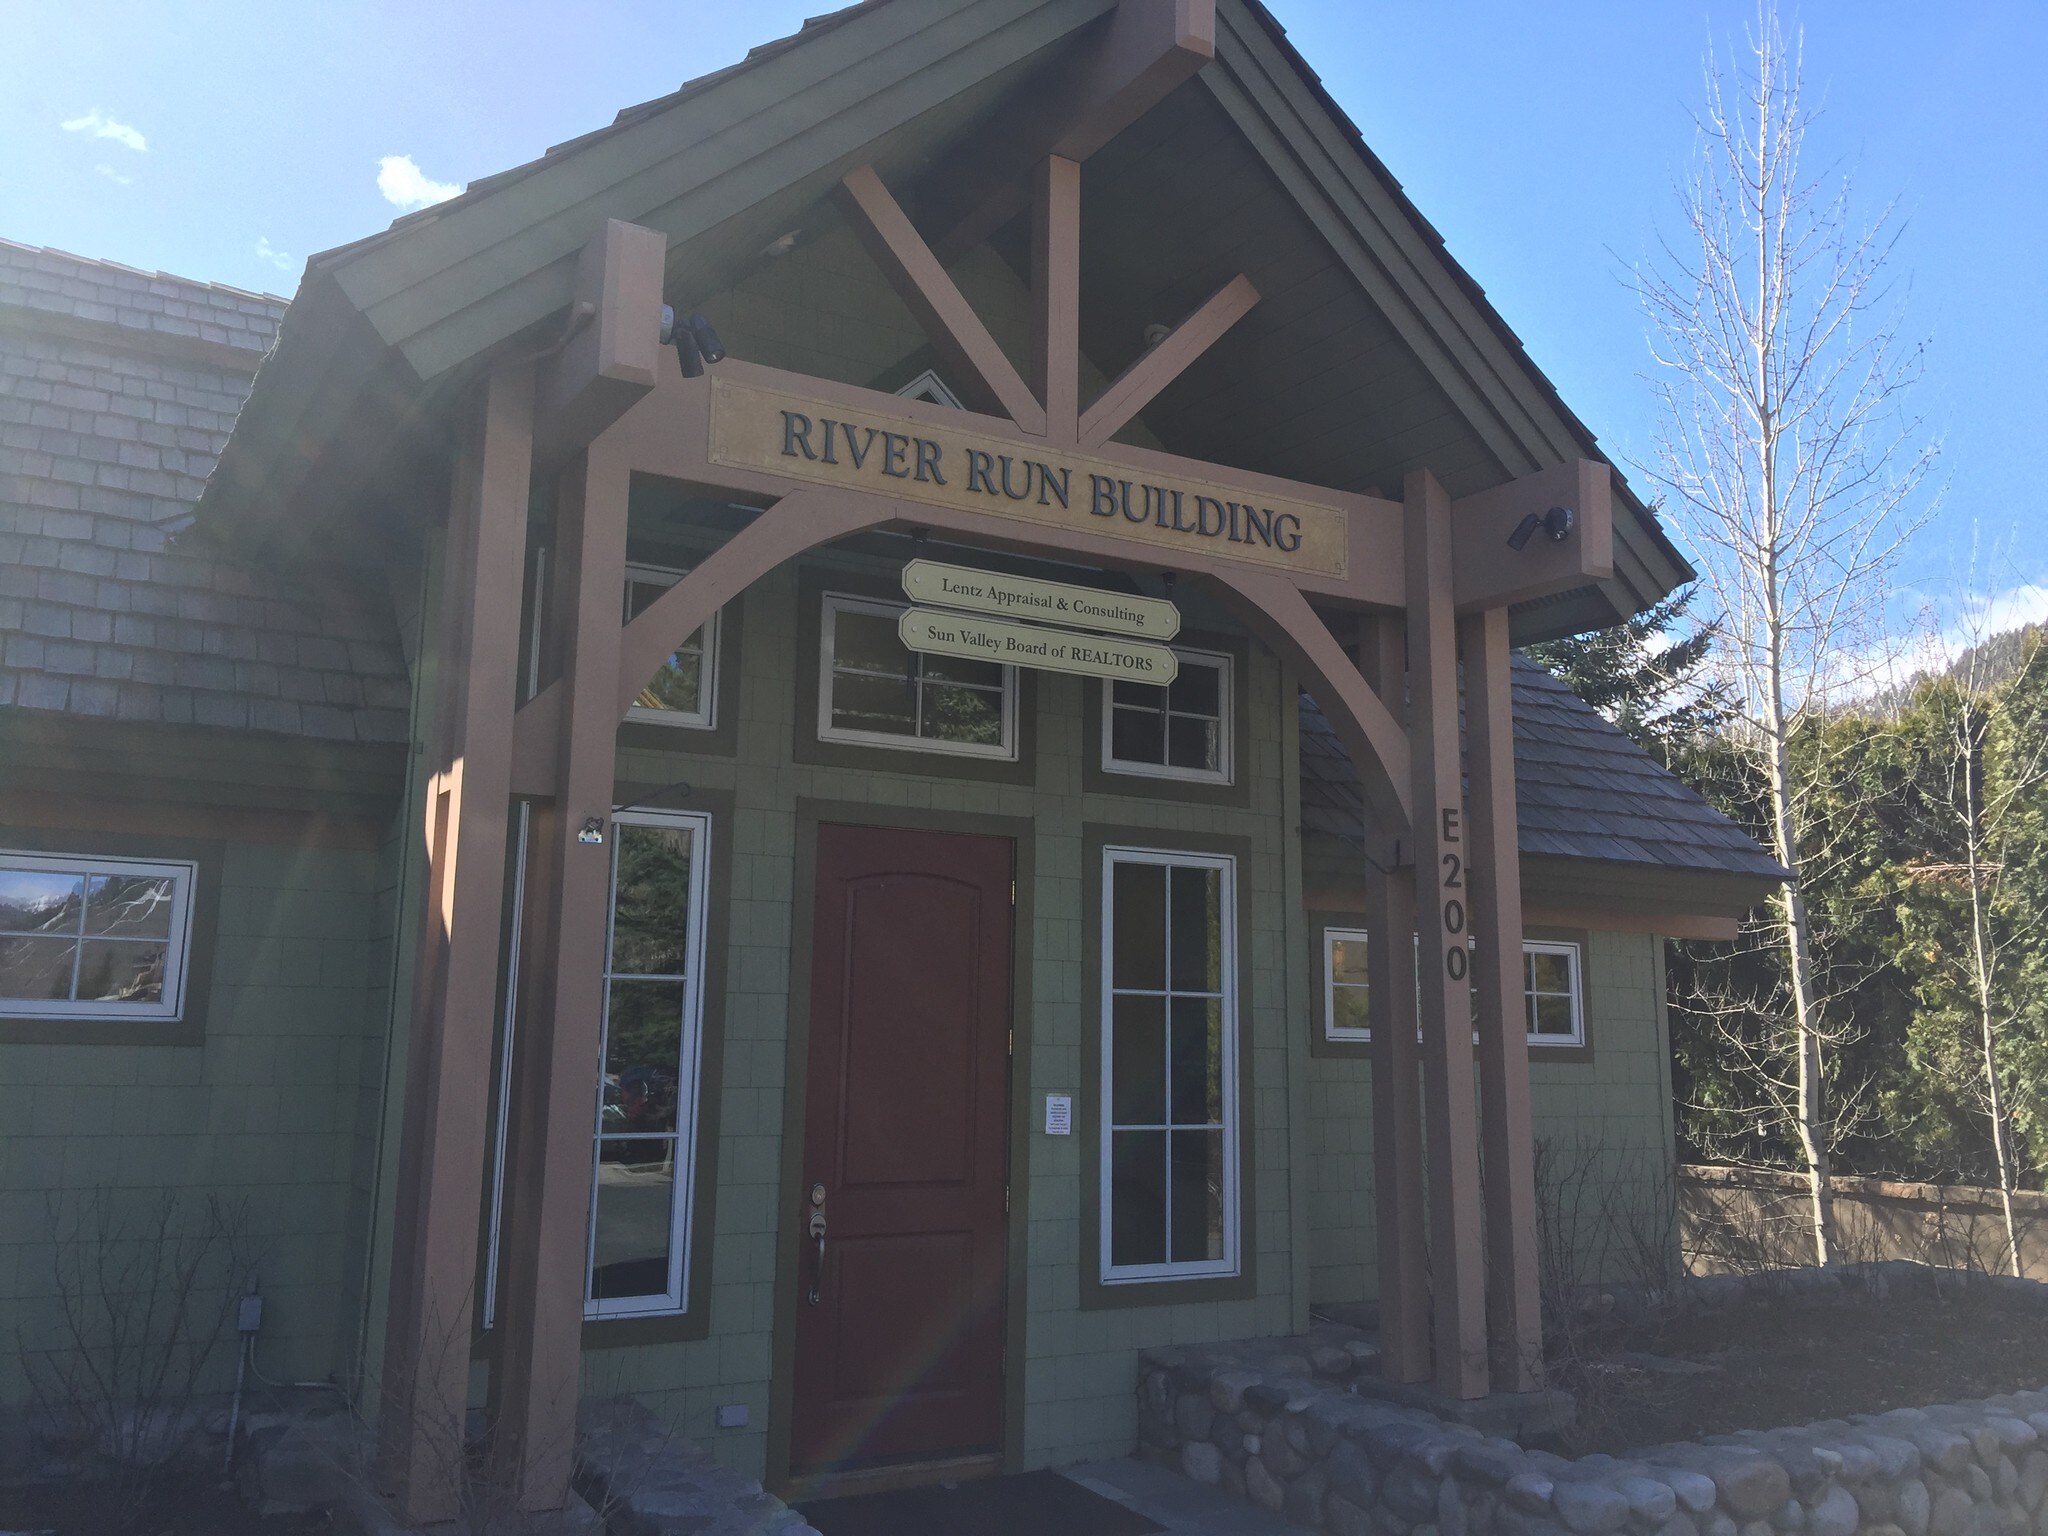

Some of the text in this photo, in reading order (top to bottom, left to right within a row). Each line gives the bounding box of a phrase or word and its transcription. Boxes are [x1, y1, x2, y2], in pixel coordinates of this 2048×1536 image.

[781, 410, 1303, 552] RIVER RUN BUILDING
[942, 578, 1145, 626] Lentz Appraisal & Consulting
[928, 625, 1153, 671] Sun Valley Board of REALTORS
